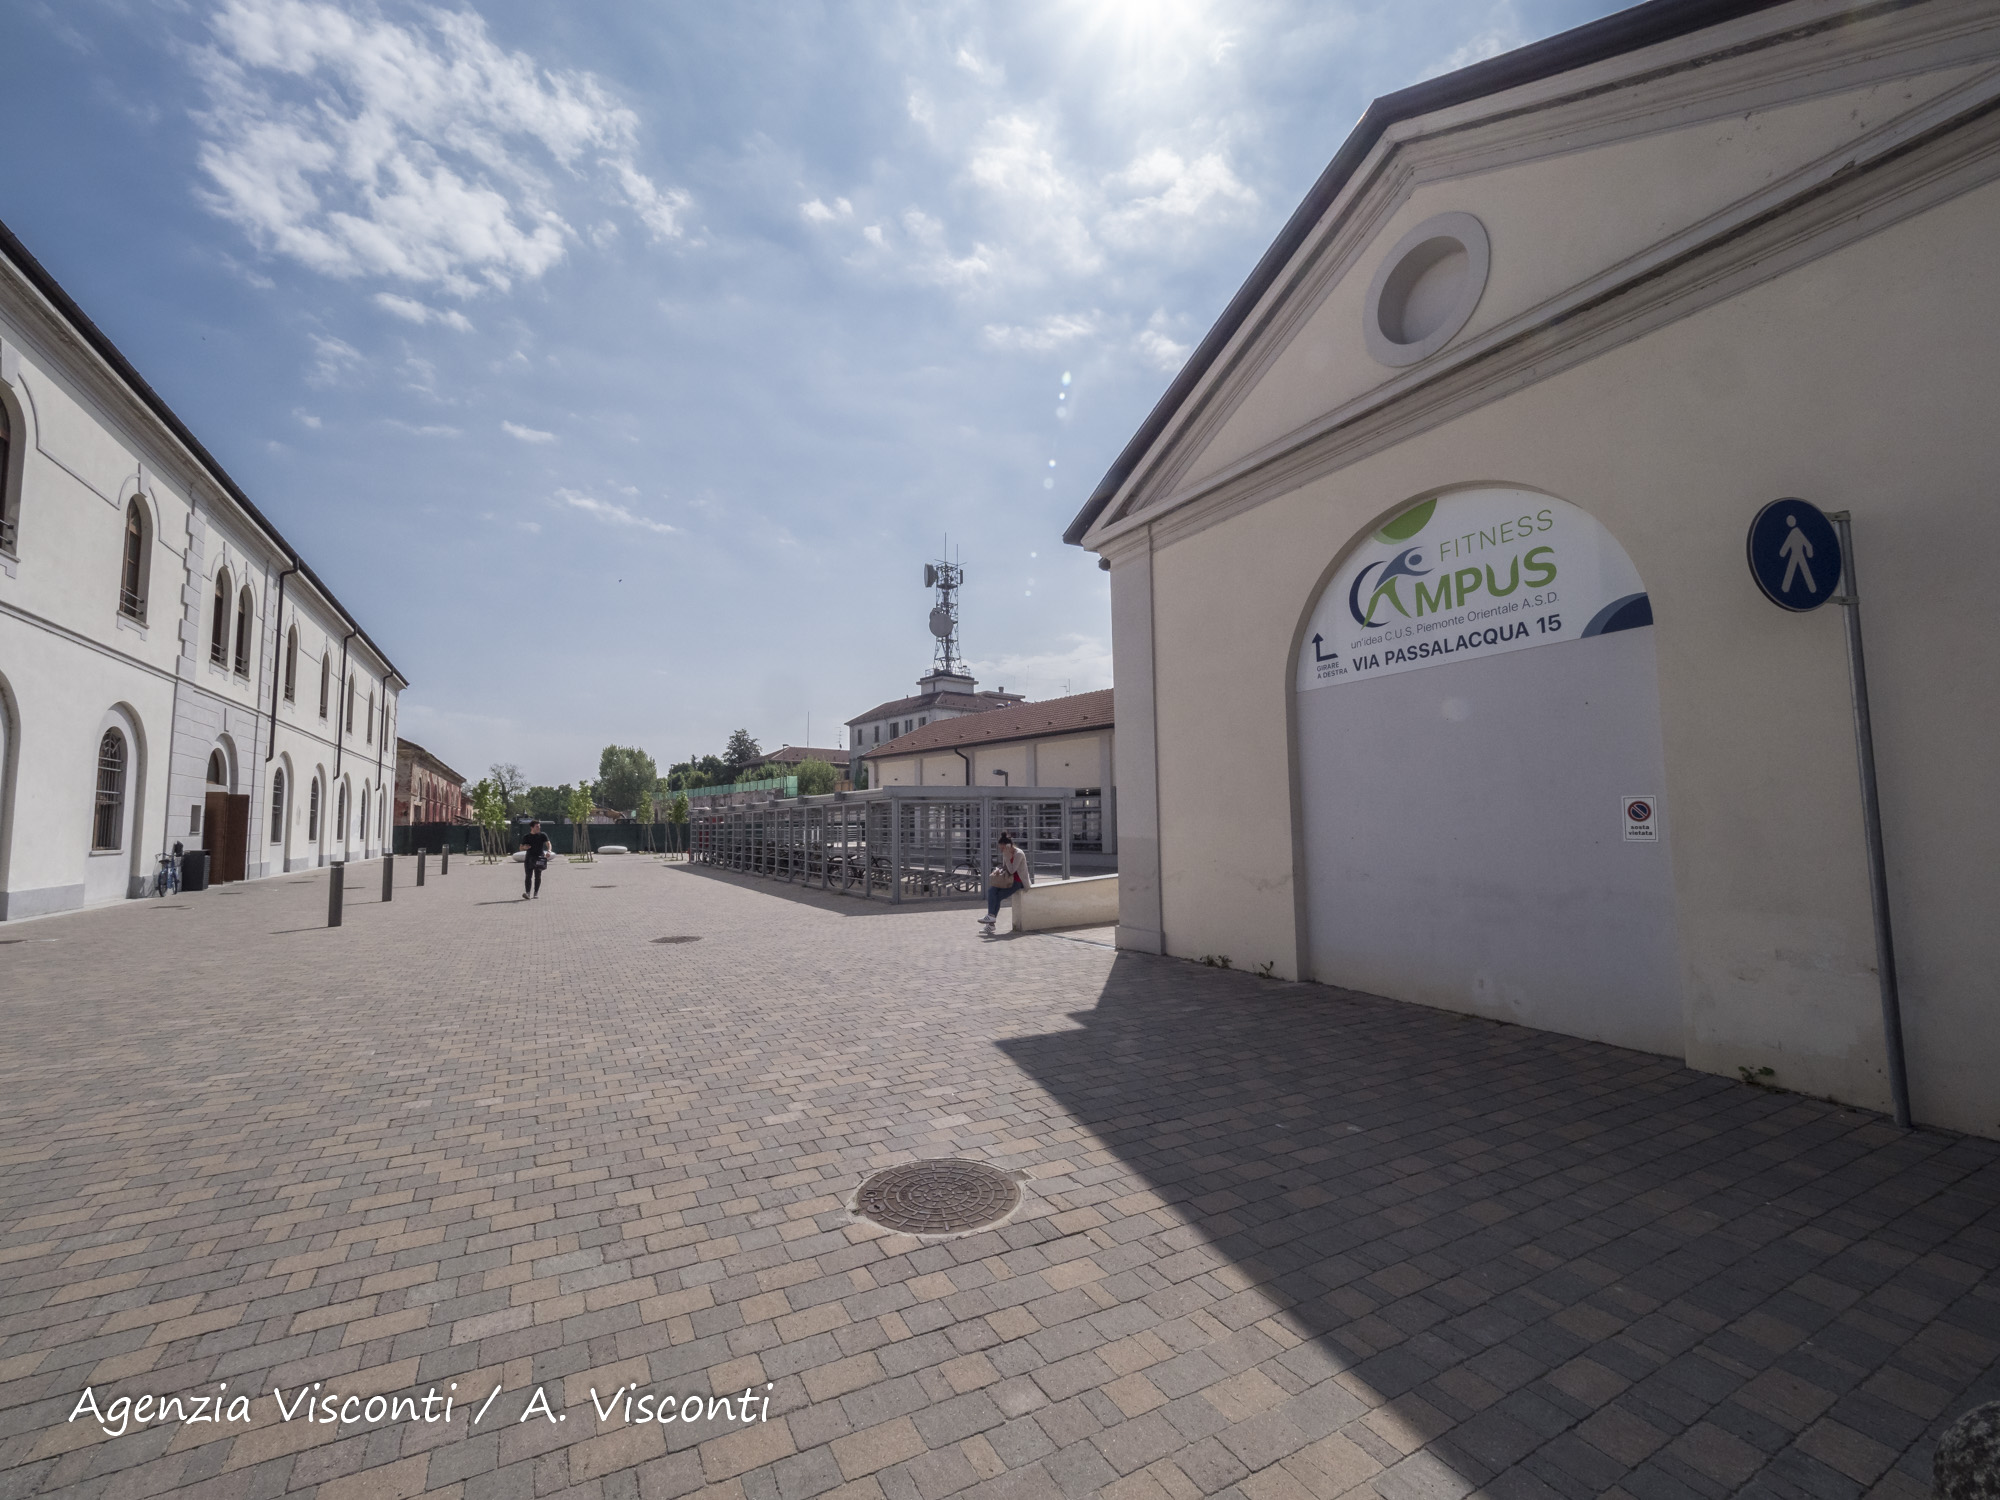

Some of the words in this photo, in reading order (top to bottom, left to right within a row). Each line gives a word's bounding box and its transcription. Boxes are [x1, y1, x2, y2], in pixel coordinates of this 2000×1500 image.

[1440, 509, 1553, 562] FITNESS
[1351, 636, 1383, 649] un'idea
[1384, 626, 1415, 642] C.U.S.
[1416, 614, 1465, 634] Piemonte
[1467, 602, 1519, 622] Orientale
[1521, 591, 1560, 610] A.S.D.
[1352, 654, 1380, 672] VIA
[1384, 621, 1530, 666] PASSALACQUA
[1536, 613, 1562, 634] 15
[1316, 661, 1340, 672] GIRARE
[1323, 667, 1349, 679] DESTRA
